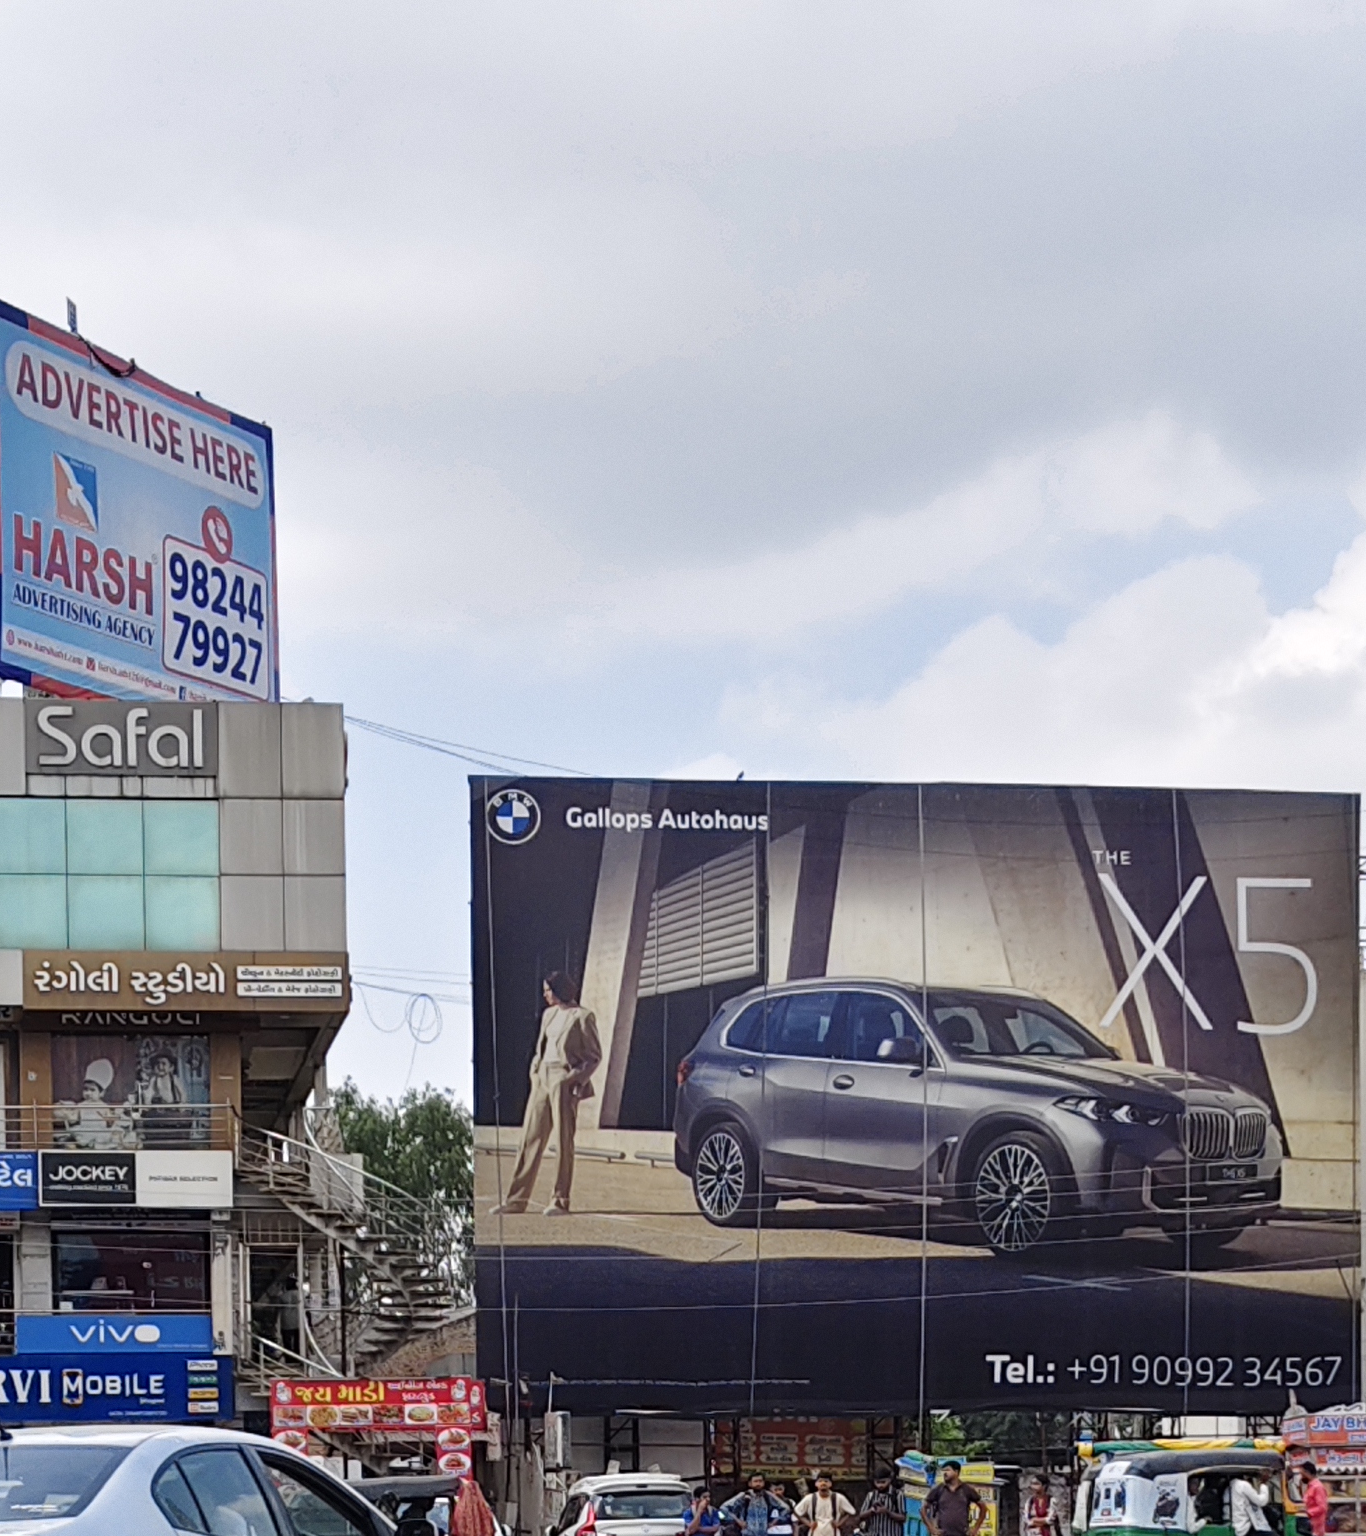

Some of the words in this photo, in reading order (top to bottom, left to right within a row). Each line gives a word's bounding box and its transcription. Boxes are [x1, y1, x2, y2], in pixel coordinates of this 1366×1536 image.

[16, 353, 184, 464] ADVERTISE
[190, 428, 259, 495] HERE
[13, 514, 154, 616] HARSH
[169, 552, 264, 631] 98244
[13, 583, 102, 630] ADVERTISING
[105, 615, 156, 647] AGENCY
[173, 612, 264, 686] 79927
[36, 706, 205, 769] Safal
[566, 807, 653, 832] Gallops
[658, 808, 768, 831] Autohaus
[1092, 850, 1132, 866] THE
[1097, 872, 1318, 1036] X5
[34, 961, 119, 993] રંગોલી
[130, 962, 226, 1006] સ્ટુડીયો
[49, 1165, 129, 1181] JOCKEY
[69, 1319, 161, 1344] vivo
[62, 1373, 166, 1402] MOBILE
[985, 1354, 1055, 1383] Tel.:
[1066, 1355, 1120, 1384] +91
[1131, 1355, 1235, 1387] 90992
[1242, 1356, 1343, 1388] 34567
[1311, 1416, 1344, 1430] JAY
